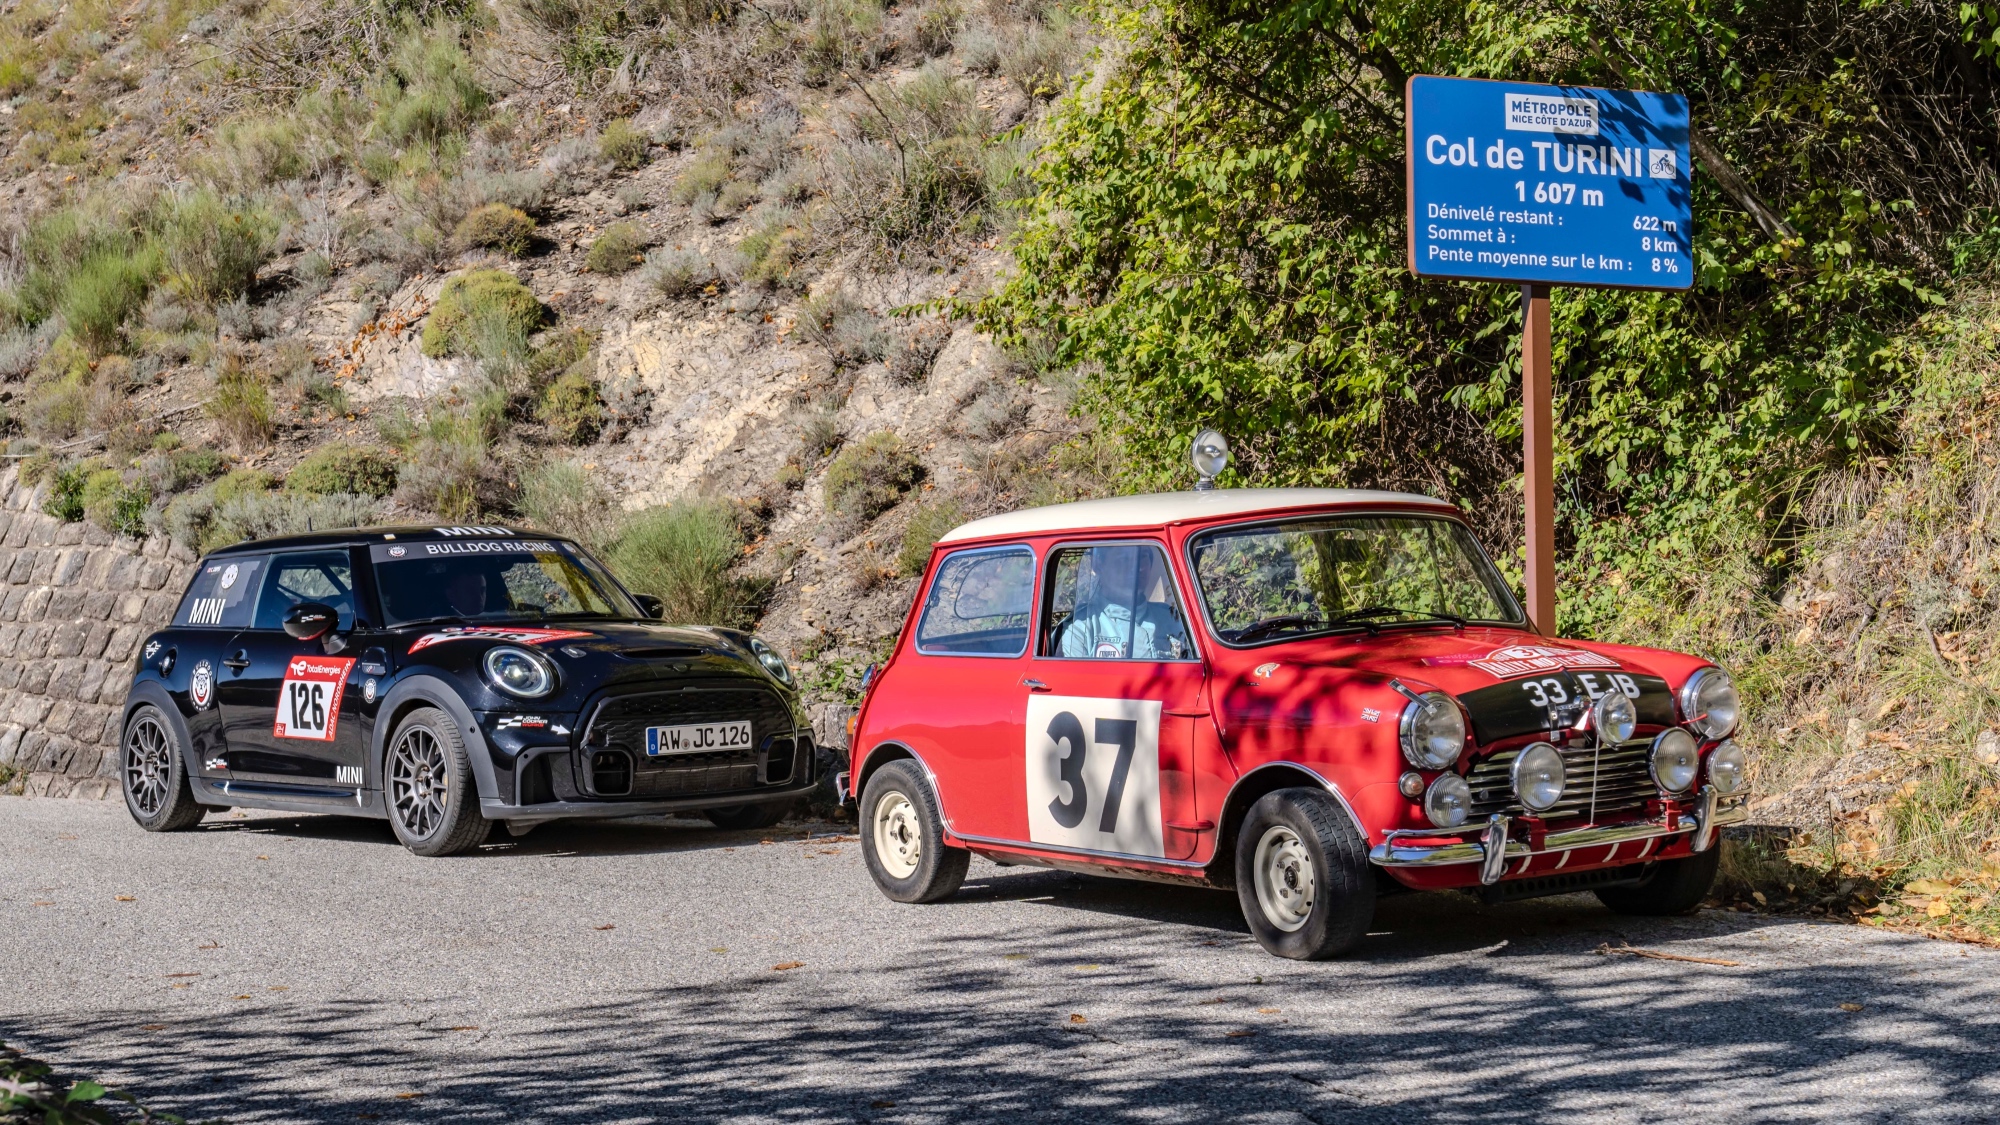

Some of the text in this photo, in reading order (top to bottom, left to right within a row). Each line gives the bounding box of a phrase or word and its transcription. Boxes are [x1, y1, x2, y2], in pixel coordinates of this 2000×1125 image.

[1511, 98, 1592, 117] MÉTROPOLE
[1511, 115, 1592, 128] NICE CÔTE D'AZUR
[1426, 135, 1642, 178] Col de TURINI
[1583, 188, 1604, 207] m
[1428, 203, 1494, 221] Dénivelé
[1499, 210, 1554, 226] restant
[1633, 216, 1677, 232] 622 m
[1427, 225, 1493, 242] Sommet
[1497, 228, 1506, 244] à
[1641, 237, 1677, 252] 8 km
[1428, 245, 1473, 262] Pente
[1478, 251, 1547, 267] moyenne
[1552, 255, 1577, 268] sur
[1582, 254, 1595, 269] le
[1600, 255, 1623, 271] km
[1651, 257, 1678, 273] 8 %
[433, 527, 515, 536] MINI
[425, 543, 503, 554] BULLDOG
[502, 542, 556, 552] RACING
[188, 598, 226, 624] MINI
[307, 664, 341, 676] TotalEnergies
[328, 660, 351, 738] ADAC NORDRHEIN
[1522, 679, 1567, 707] 33
[289, 683, 325, 730] 126
[659, 730, 680, 750] AW
[693, 728, 715, 748] JC
[719, 726, 750, 746] 126
[336, 765, 363, 784] MINI
[1046, 711, 1137, 833] 37
